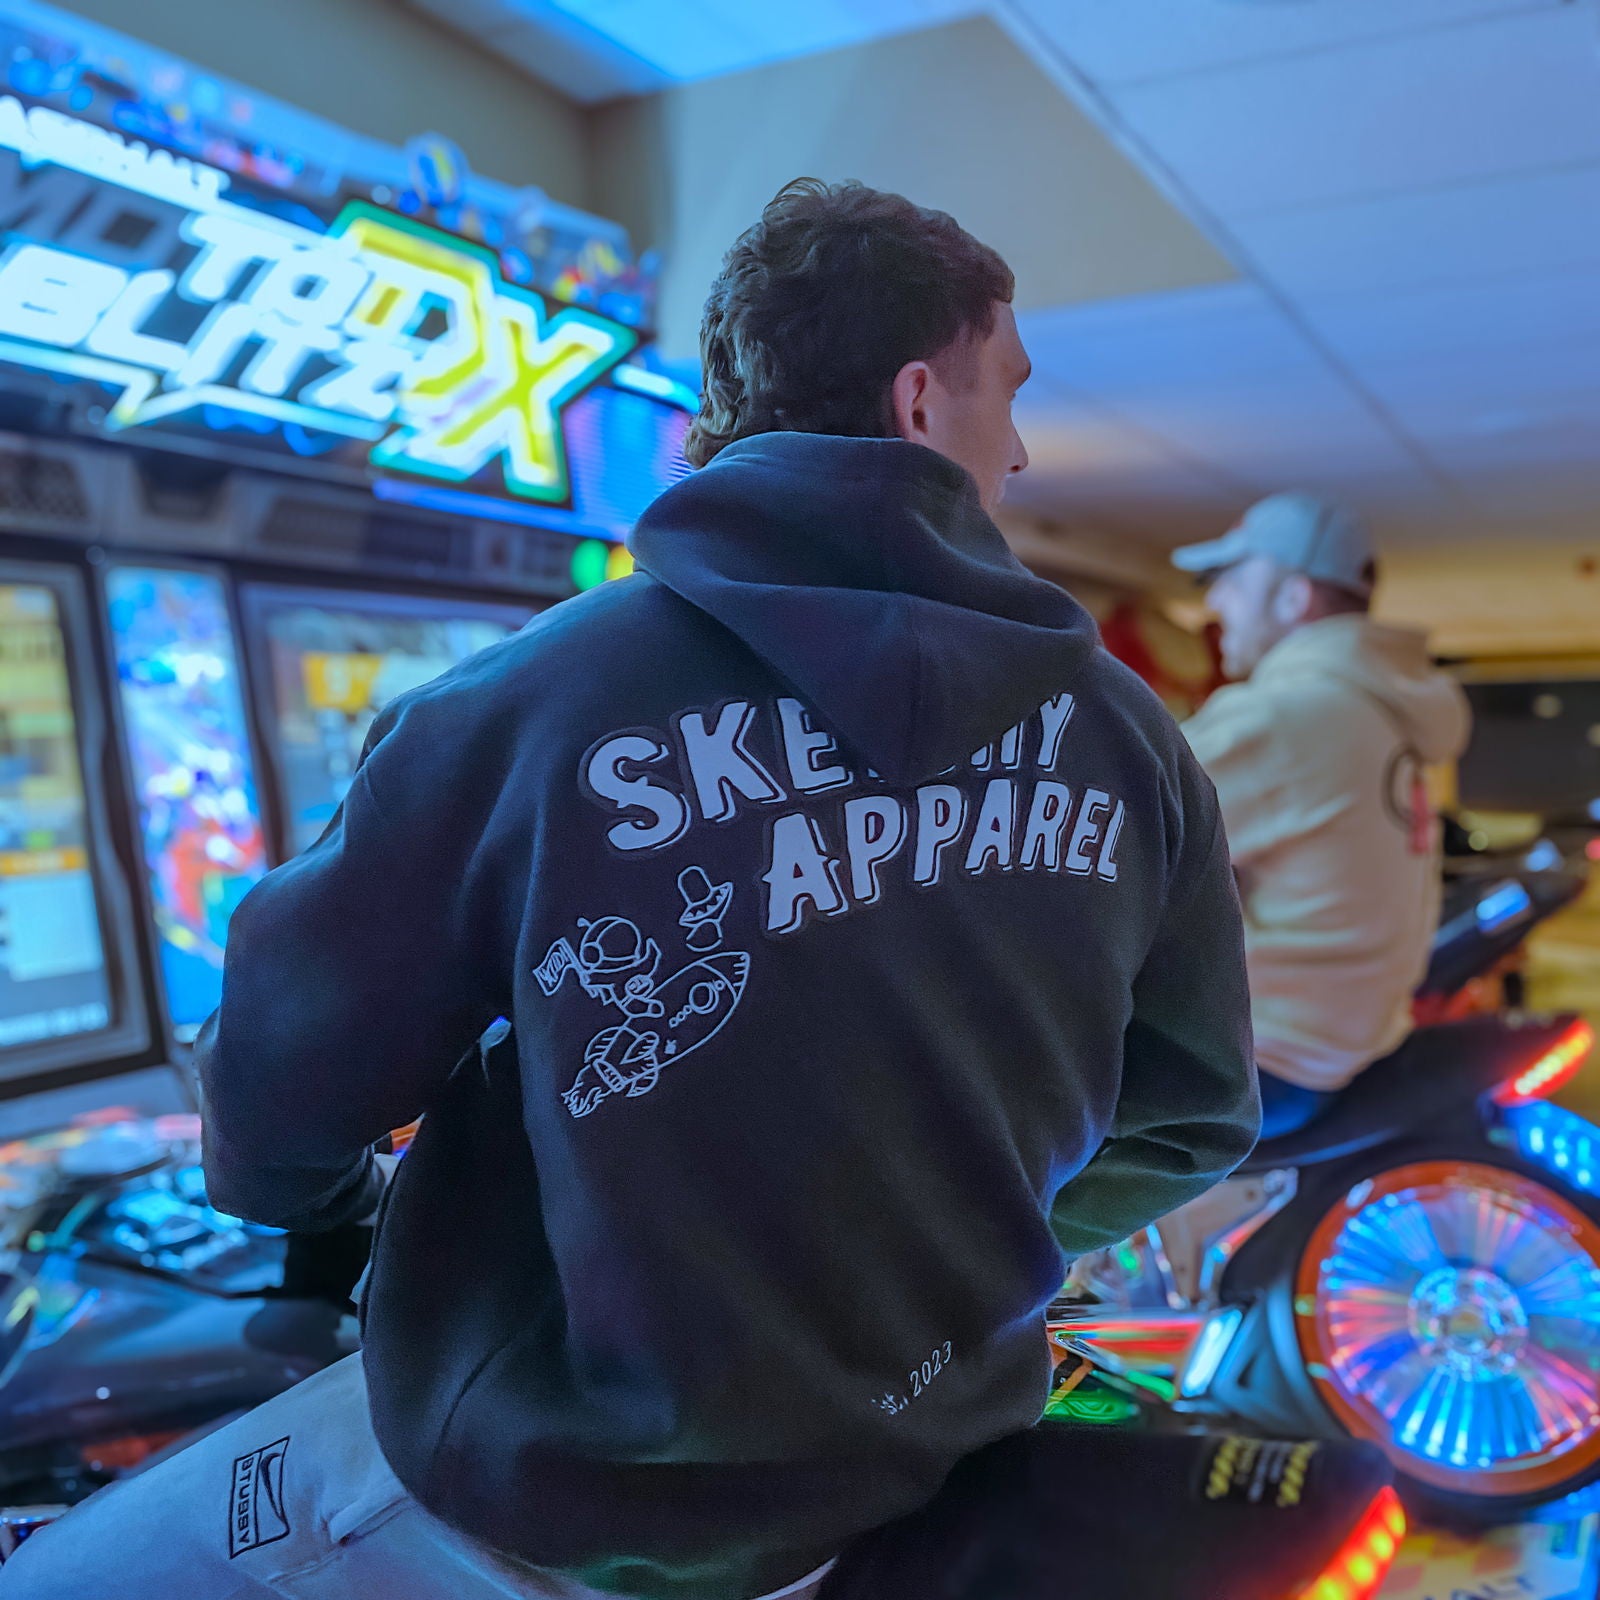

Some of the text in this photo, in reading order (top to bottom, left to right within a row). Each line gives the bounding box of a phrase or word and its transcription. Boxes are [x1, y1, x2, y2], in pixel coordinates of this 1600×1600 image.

[0, 243, 412, 419] BLITZ
[587, 691, 1075, 850] SKEY
[762, 777, 1126, 934] APPAREL
[909, 1340, 952, 1397] 2023
